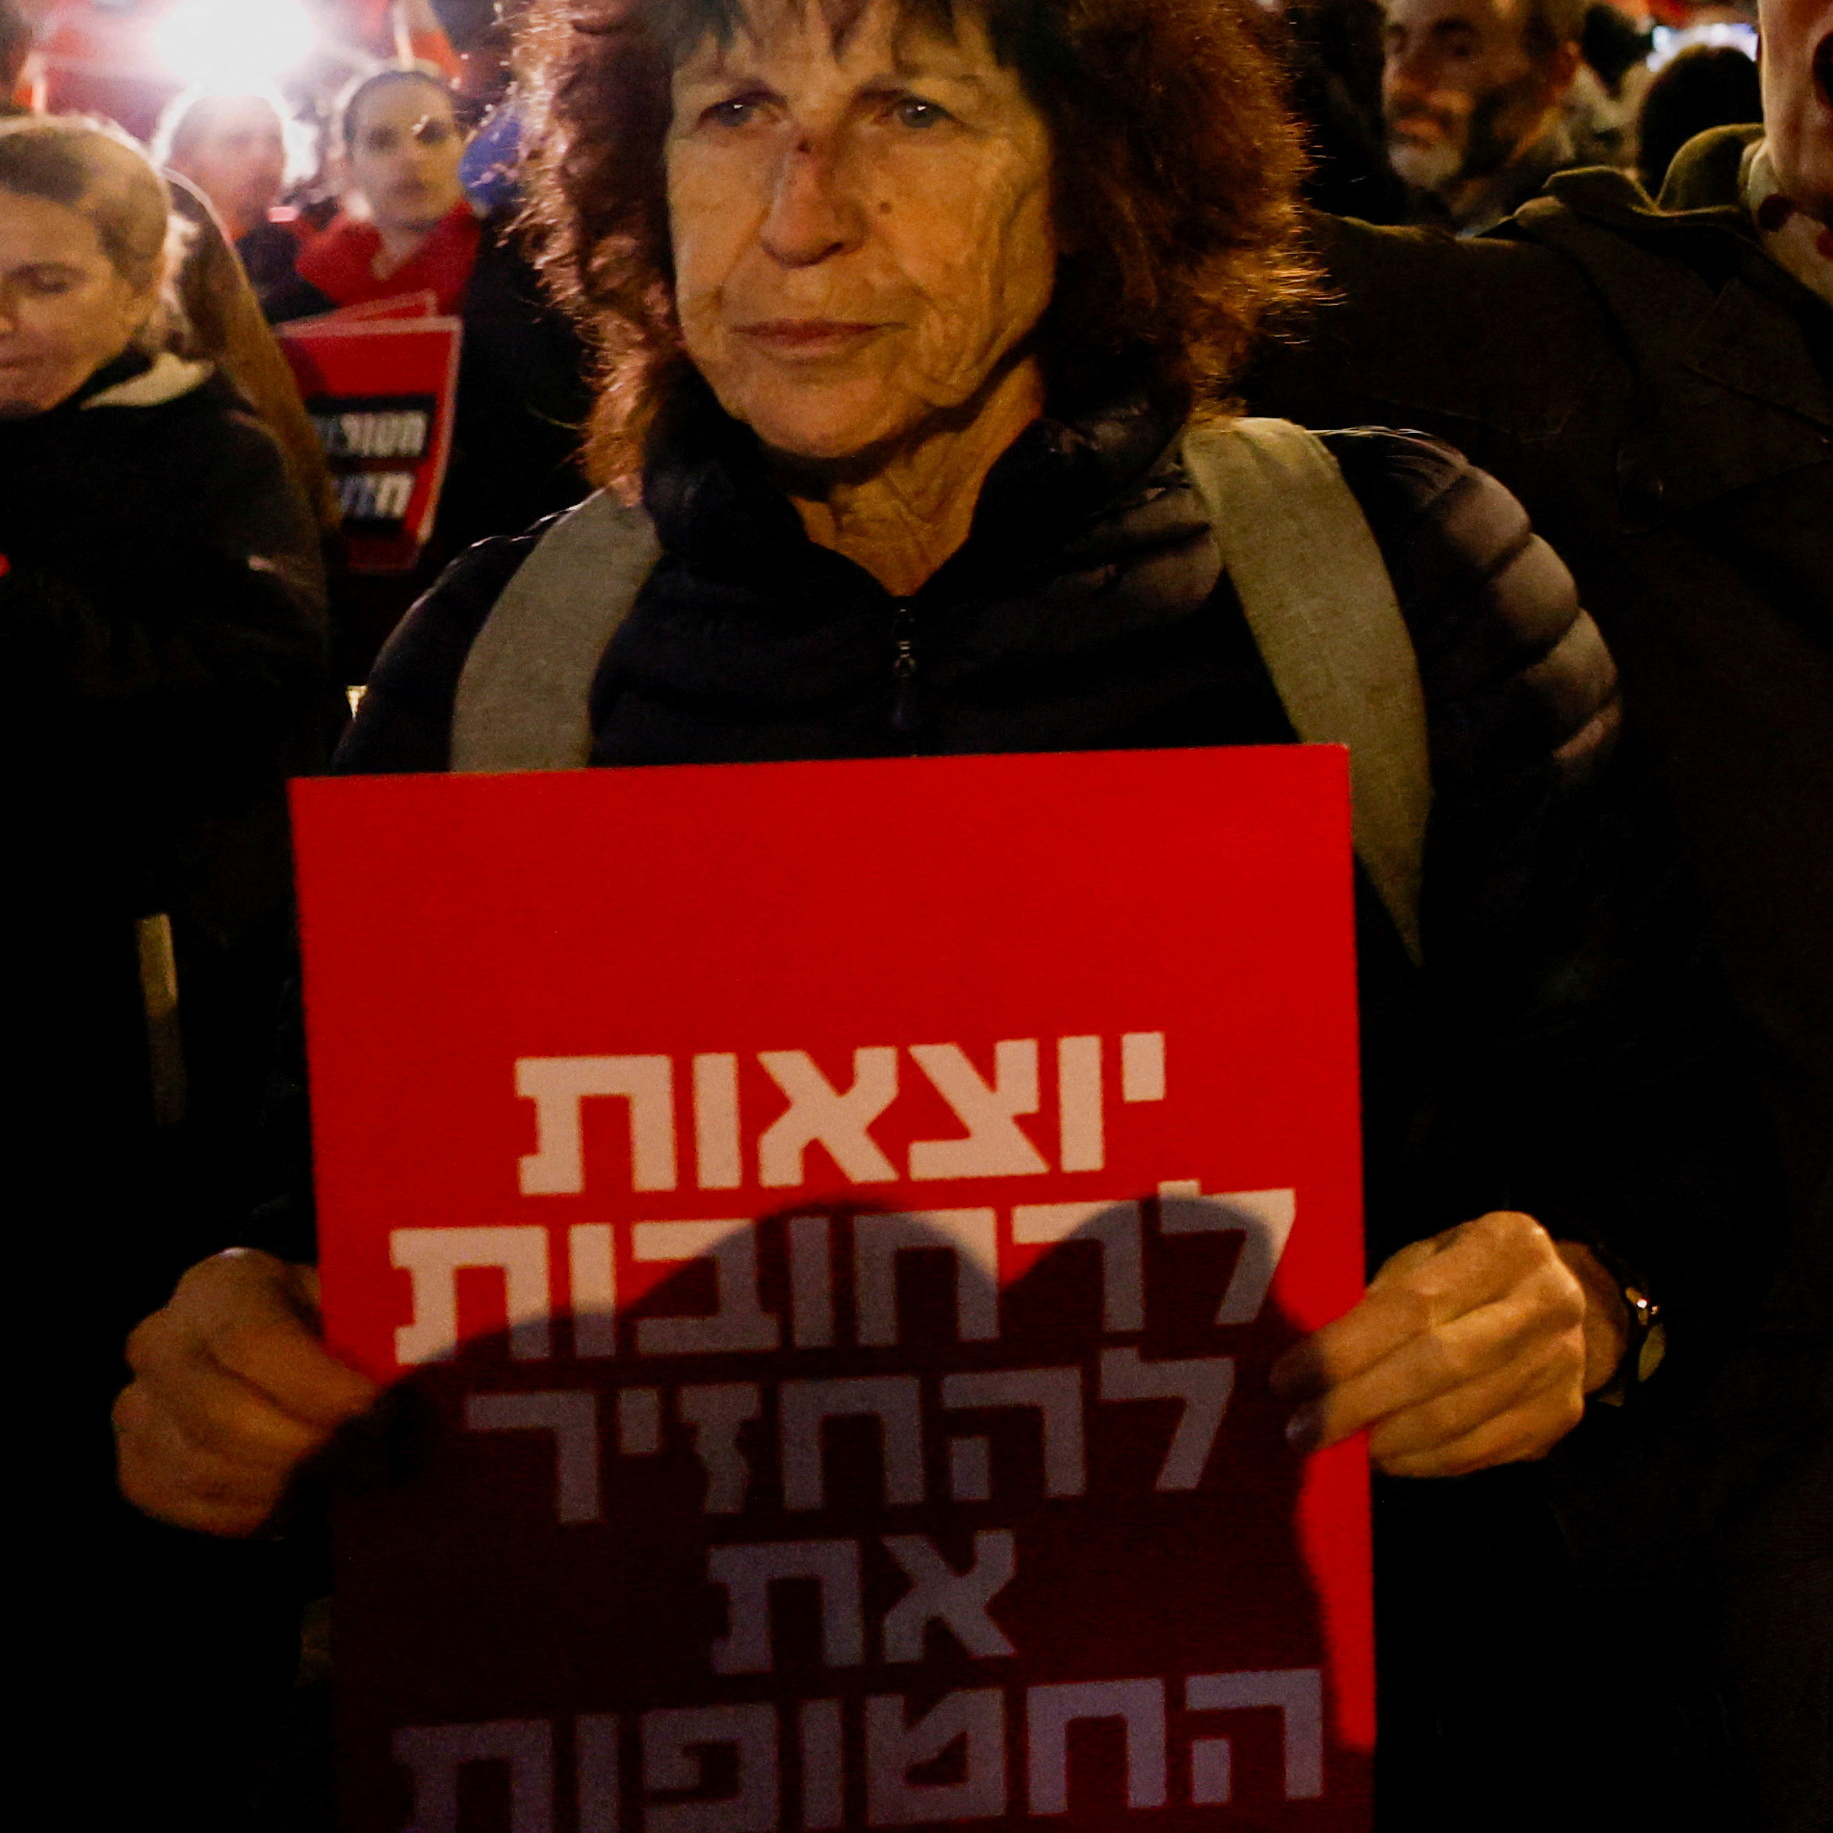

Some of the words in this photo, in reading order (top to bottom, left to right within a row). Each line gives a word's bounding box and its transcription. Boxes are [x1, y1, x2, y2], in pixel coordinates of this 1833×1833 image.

[516, 1032, 1165, 1195] יוצאות
[391, 1180, 1297, 1364] לרחובות
[466, 1349, 1236, 1524] להחזיר
[708, 1529, 1016, 1675] את
[391, 1669, 1323, 1833] החטופות
